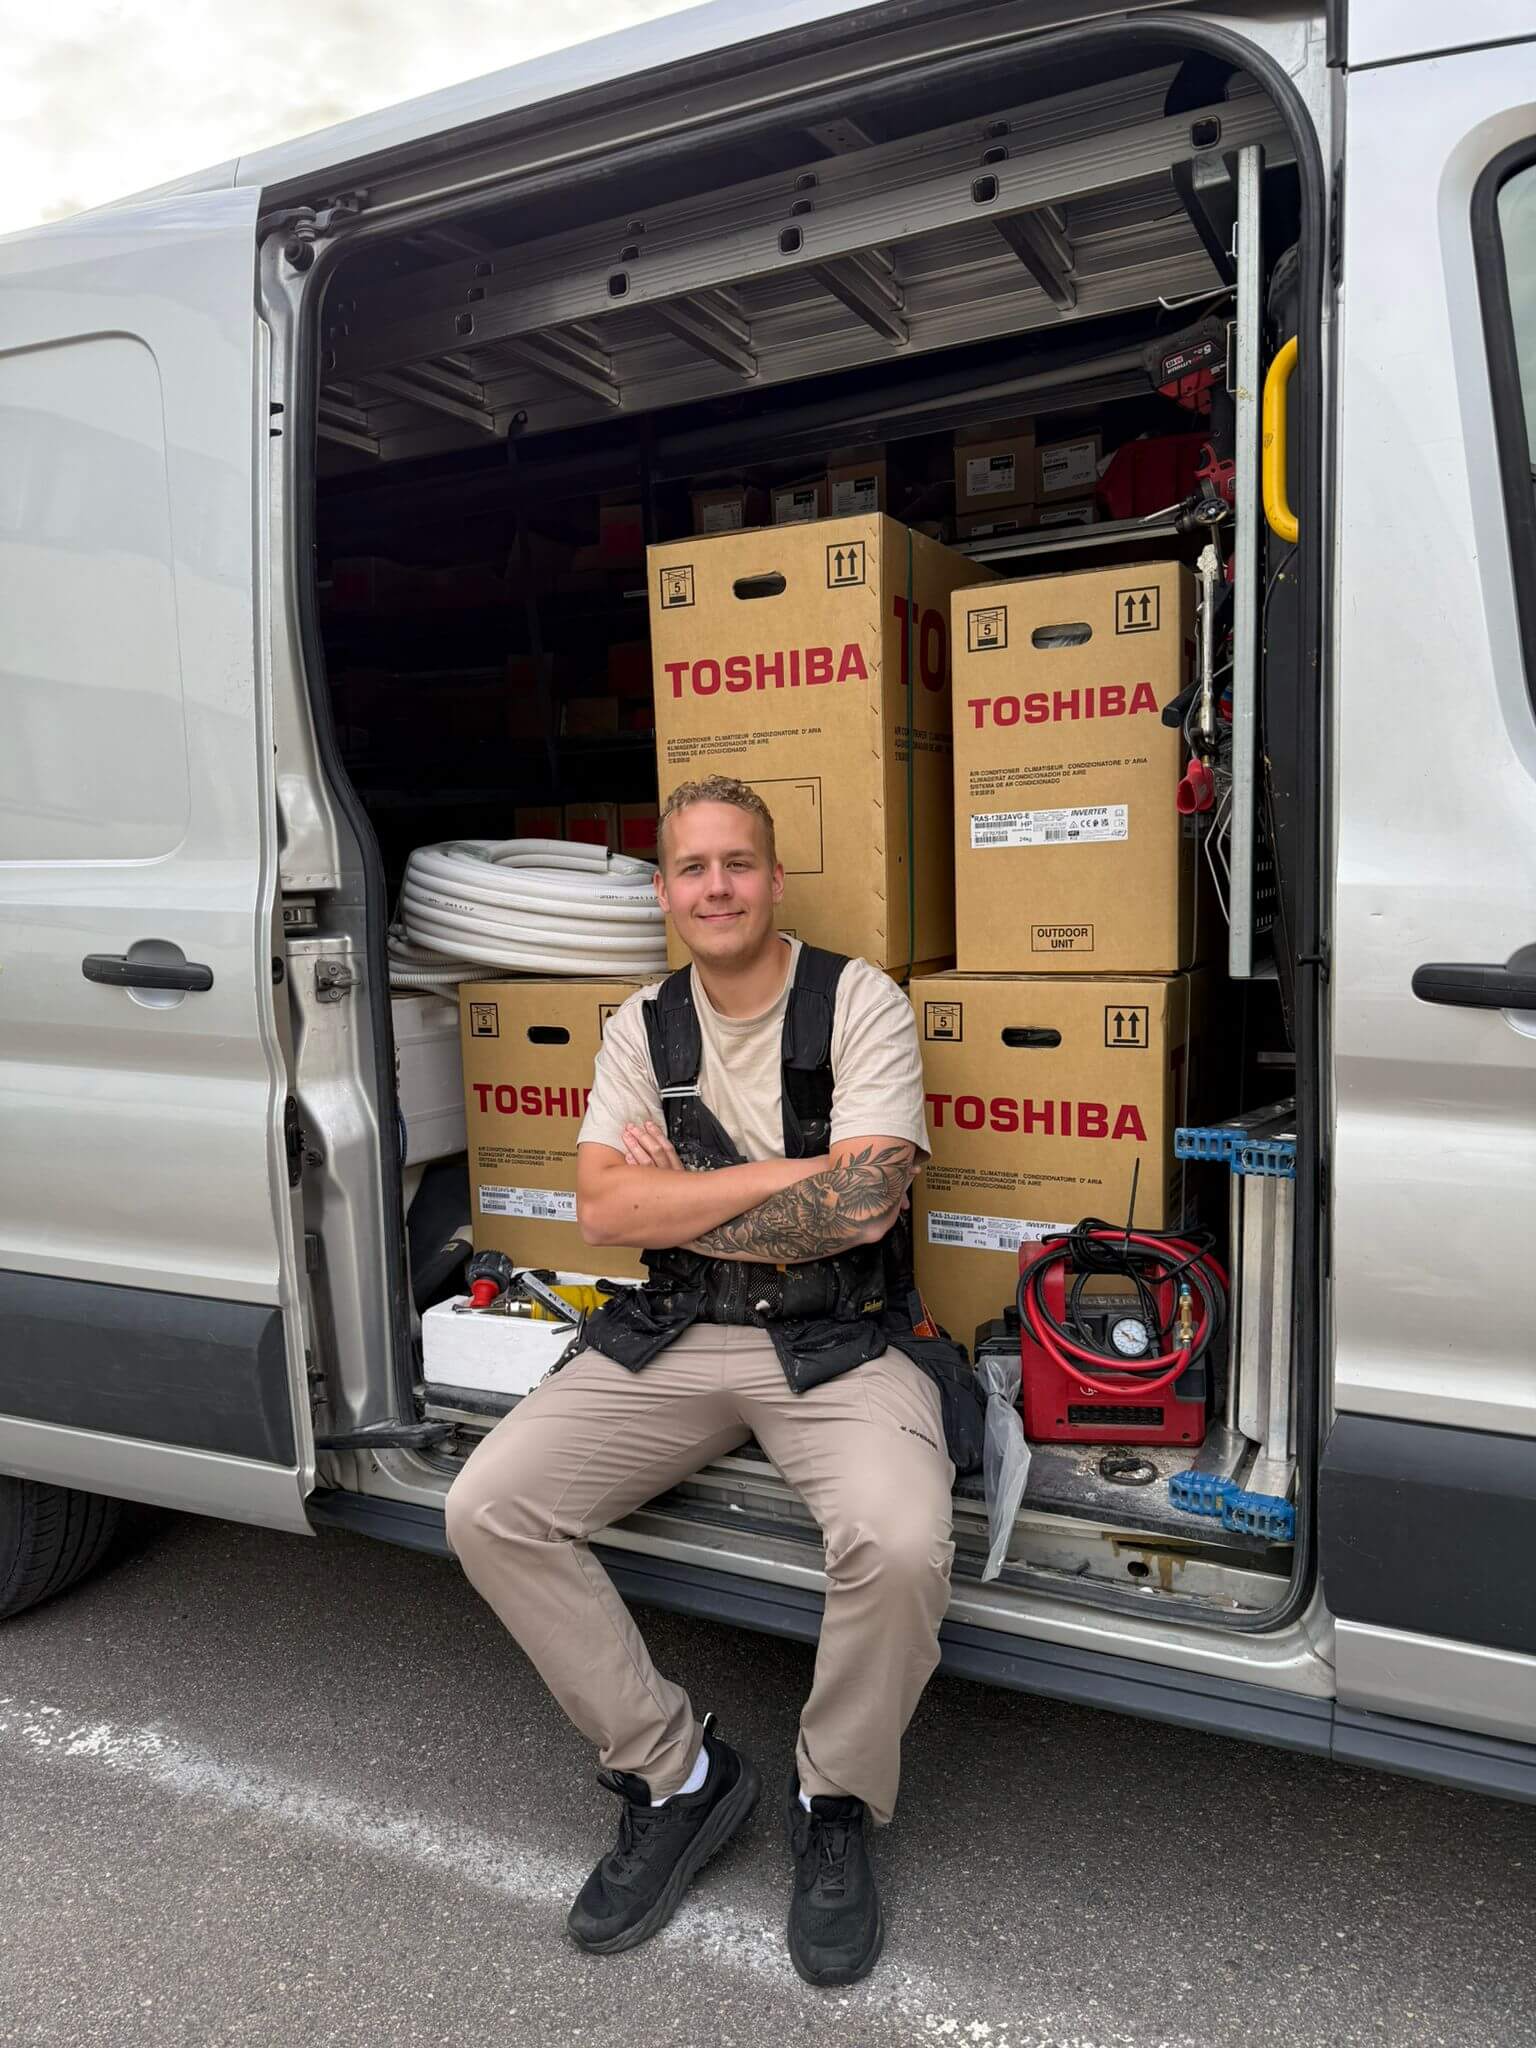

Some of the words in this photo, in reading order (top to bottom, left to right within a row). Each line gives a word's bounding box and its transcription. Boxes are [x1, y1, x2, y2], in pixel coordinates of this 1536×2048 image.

[675, 582, 680, 593] 5
[985, 624, 991, 635] 5
[664, 643, 868, 698] TOSHIBA
[968, 682, 1159, 728] TOSHIBA
[1071, 807, 1107, 817] INVERTER
[1038, 928, 1088, 937] OUTDOOR
[1051, 939, 1074, 948] UNIT
[941, 1017, 947, 1027] 5
[926, 1093, 1147, 1141] TOSHIBA
